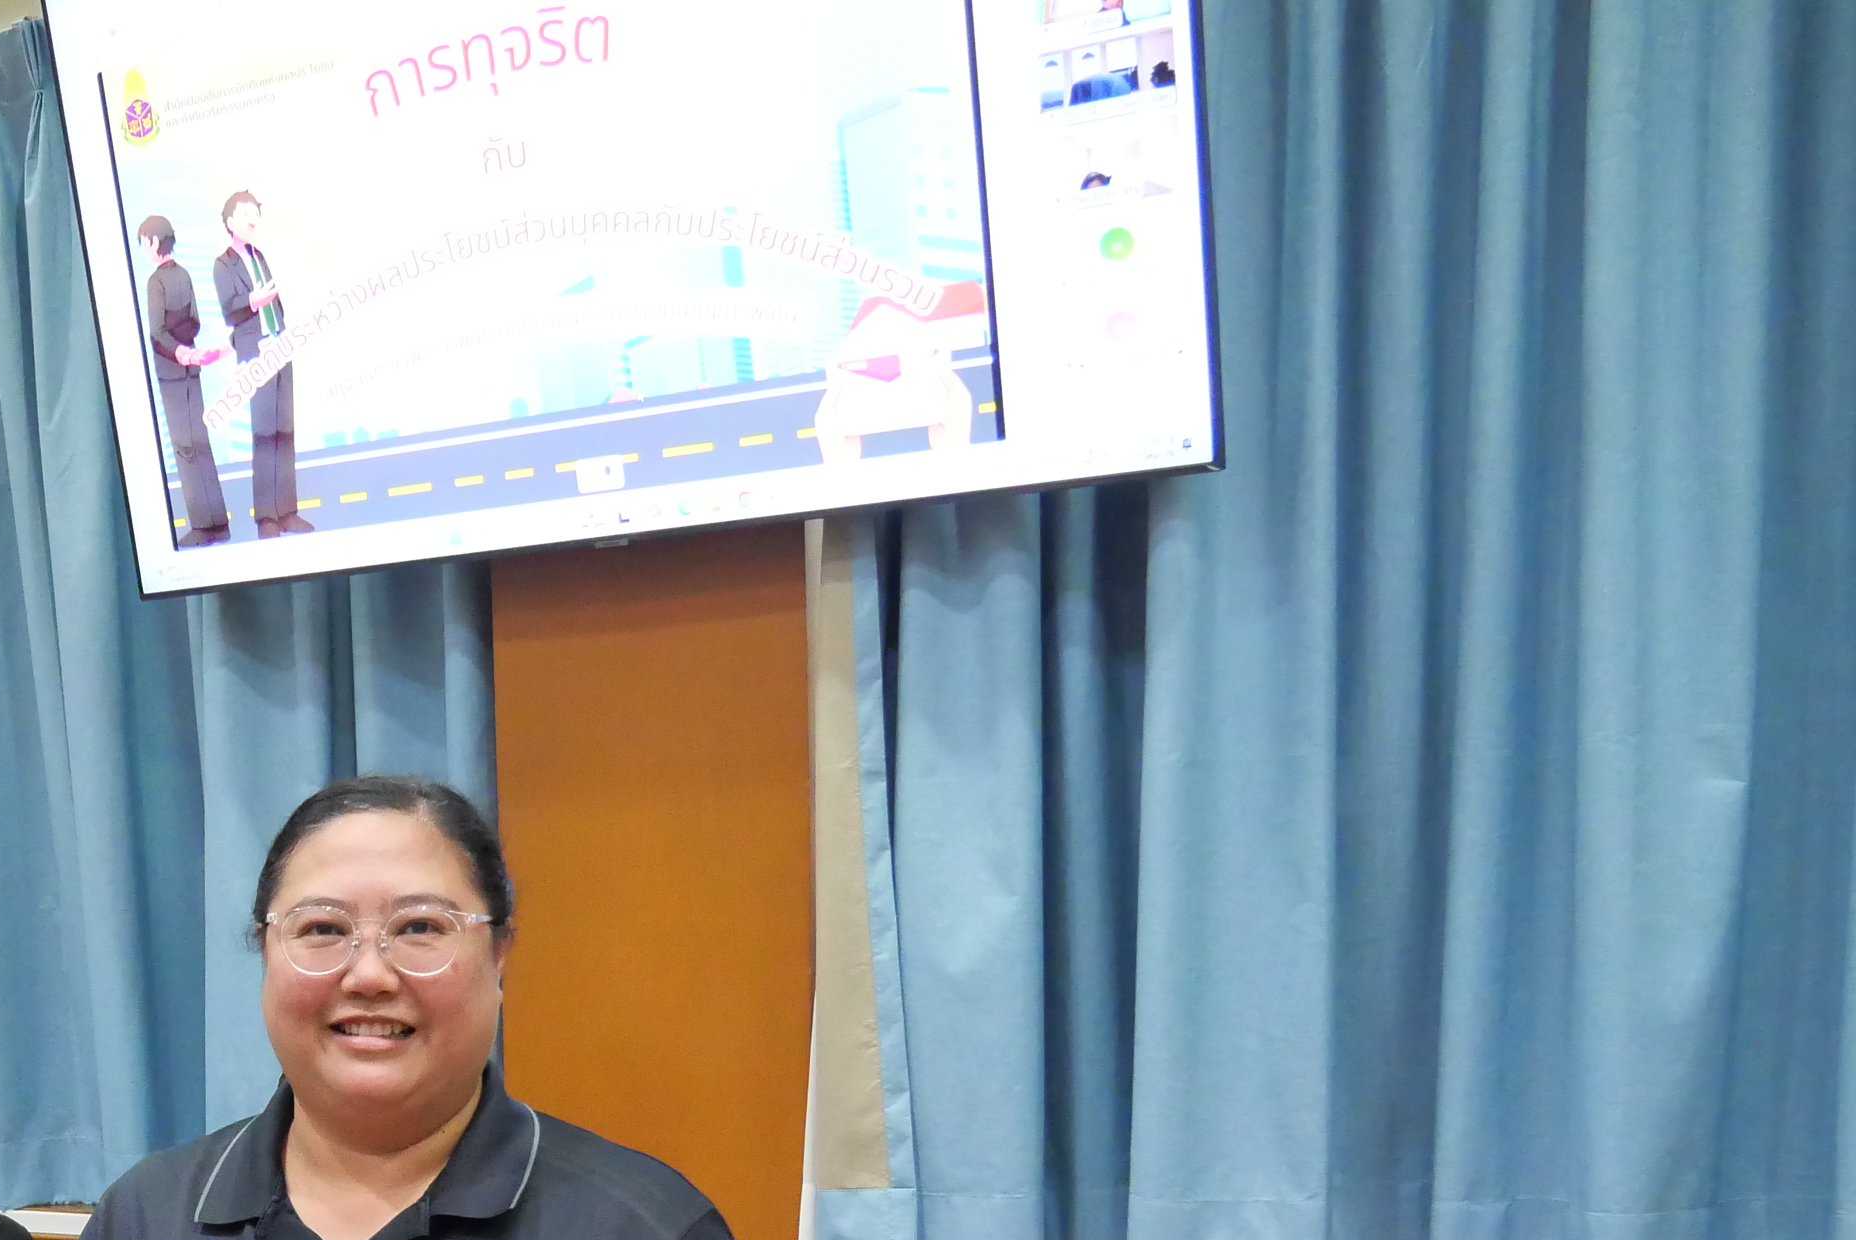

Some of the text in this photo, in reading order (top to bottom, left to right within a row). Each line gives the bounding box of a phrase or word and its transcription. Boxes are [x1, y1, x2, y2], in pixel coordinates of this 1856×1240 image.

[363, 5, 611, 119] การทุจริต
[481, 136, 528, 176] กับ
